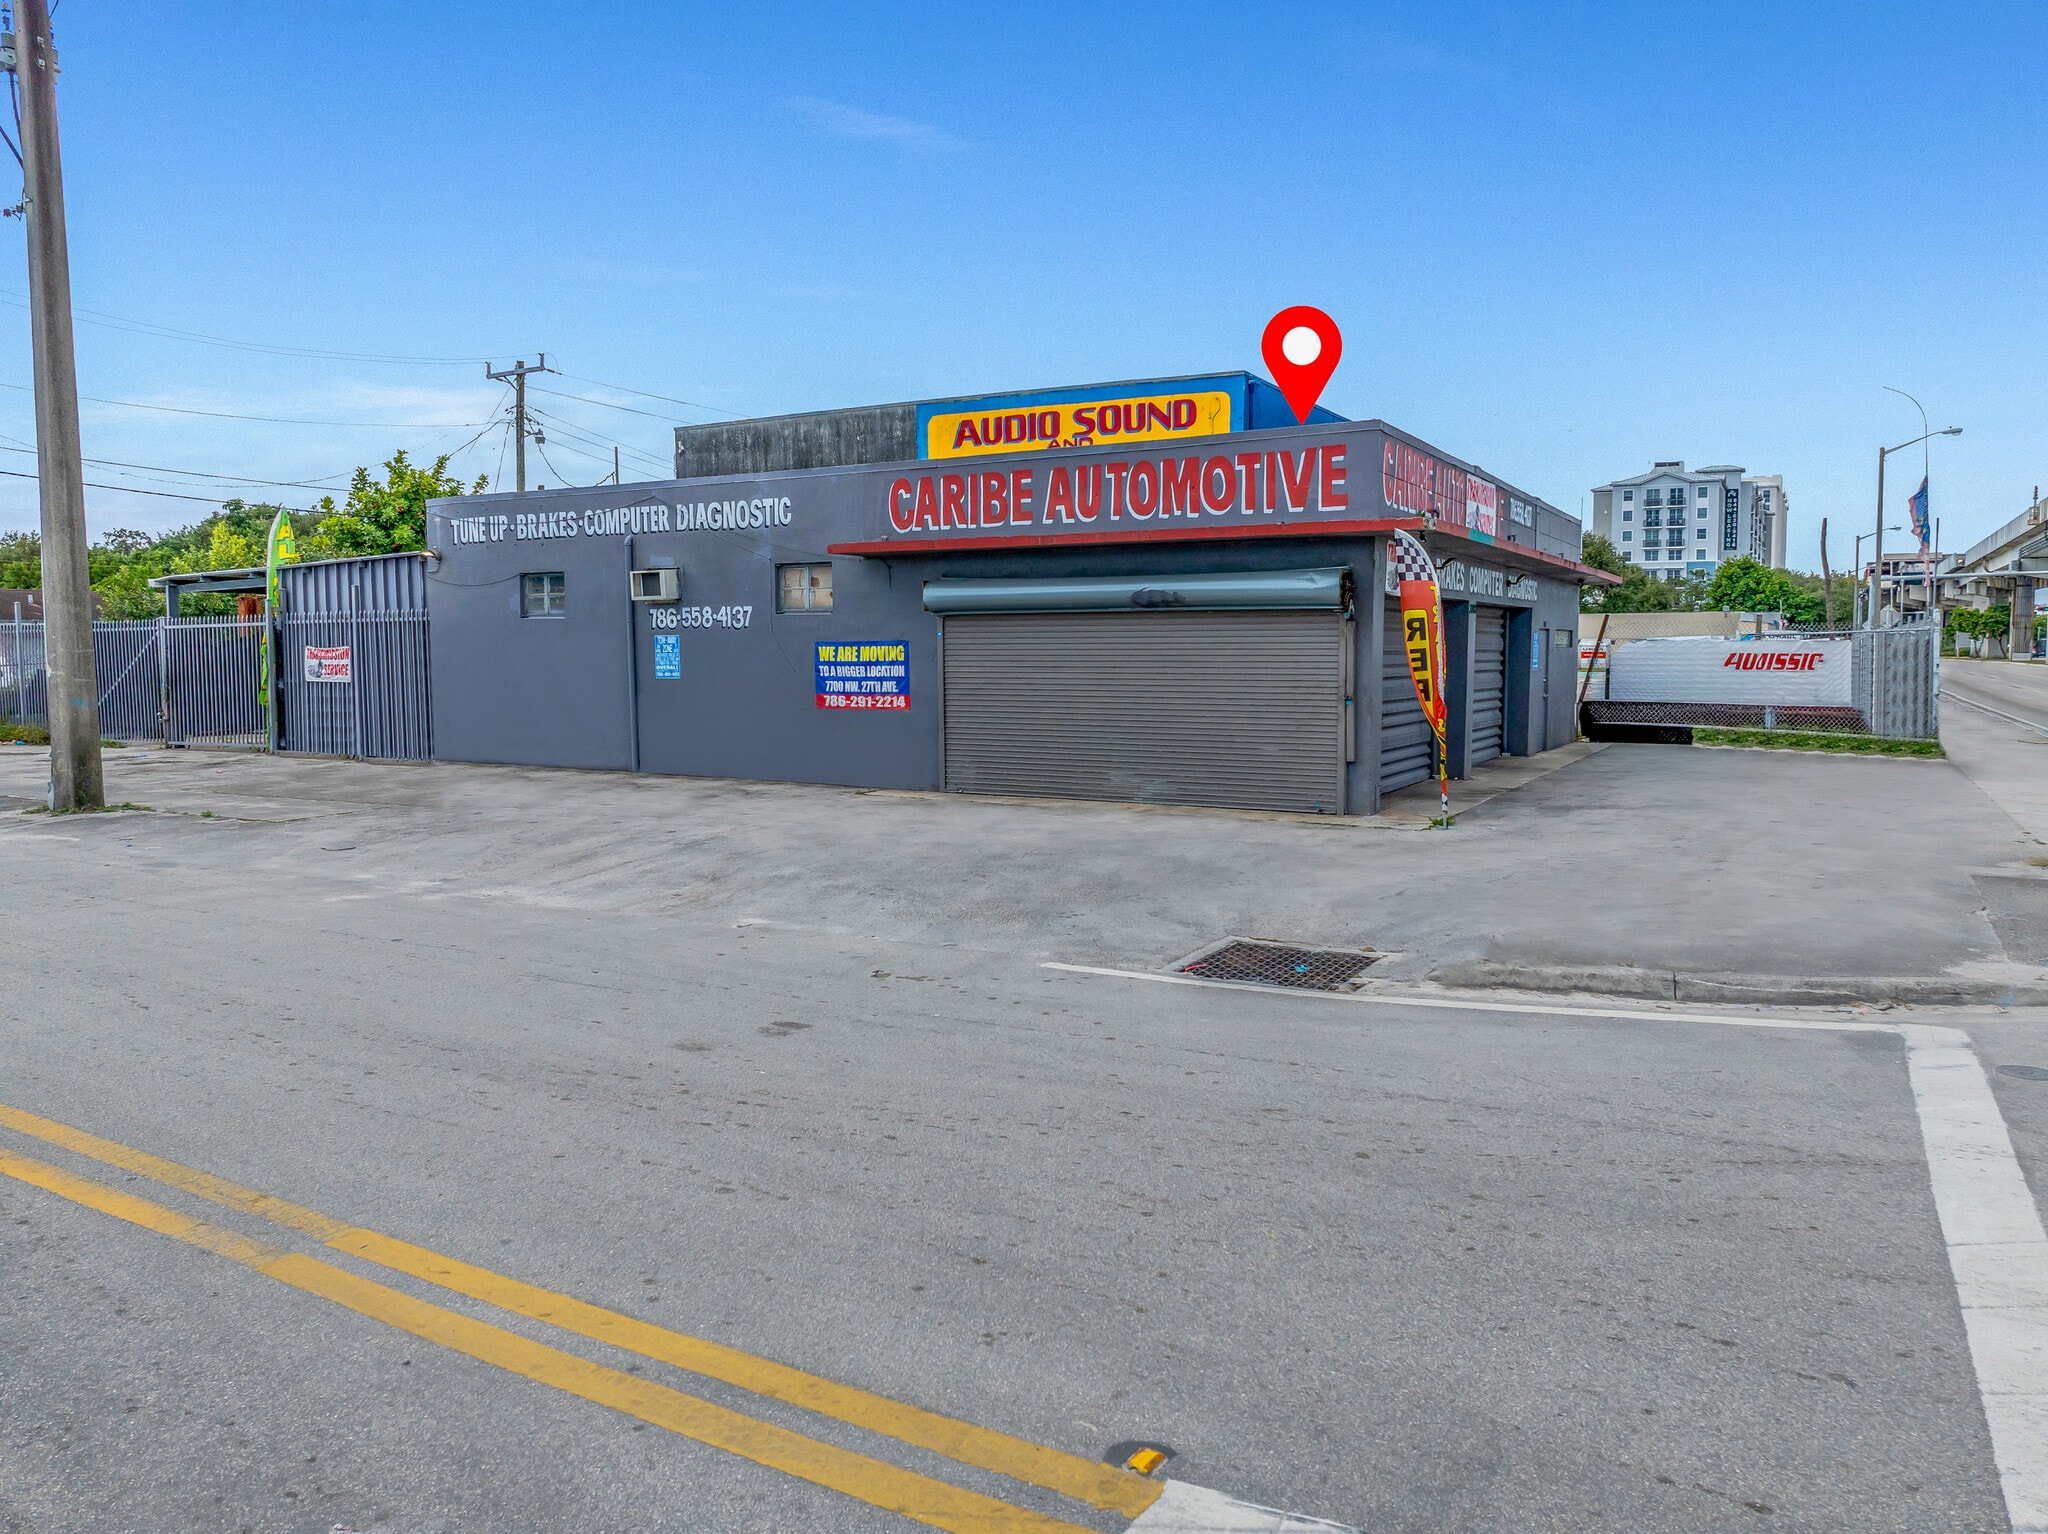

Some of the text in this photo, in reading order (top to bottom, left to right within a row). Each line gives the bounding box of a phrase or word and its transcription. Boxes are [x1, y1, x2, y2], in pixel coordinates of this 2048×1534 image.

[953, 398, 1197, 450] AUDIO SOUND
[889, 443, 1349, 534] CARIBE AUTOMOTIVE
[1383, 440, 1433, 518] CARIBE
[451, 496, 792, 545] TUNE UP BRAKES COMPUTER DIAGNOSTIC
[1469, 566, 1503, 597] COMPUTER
[1507, 575, 1538, 601] DIAGNOSTIC
[818, 645, 905, 662] WE ARE MOVING
[819, 665, 905, 677] TO A BIGGER LOCATION
[824, 695, 906, 708] 786-291-2214
[825, 681, 843, 692] 7700
[861, 681, 881, 693] 27TH
